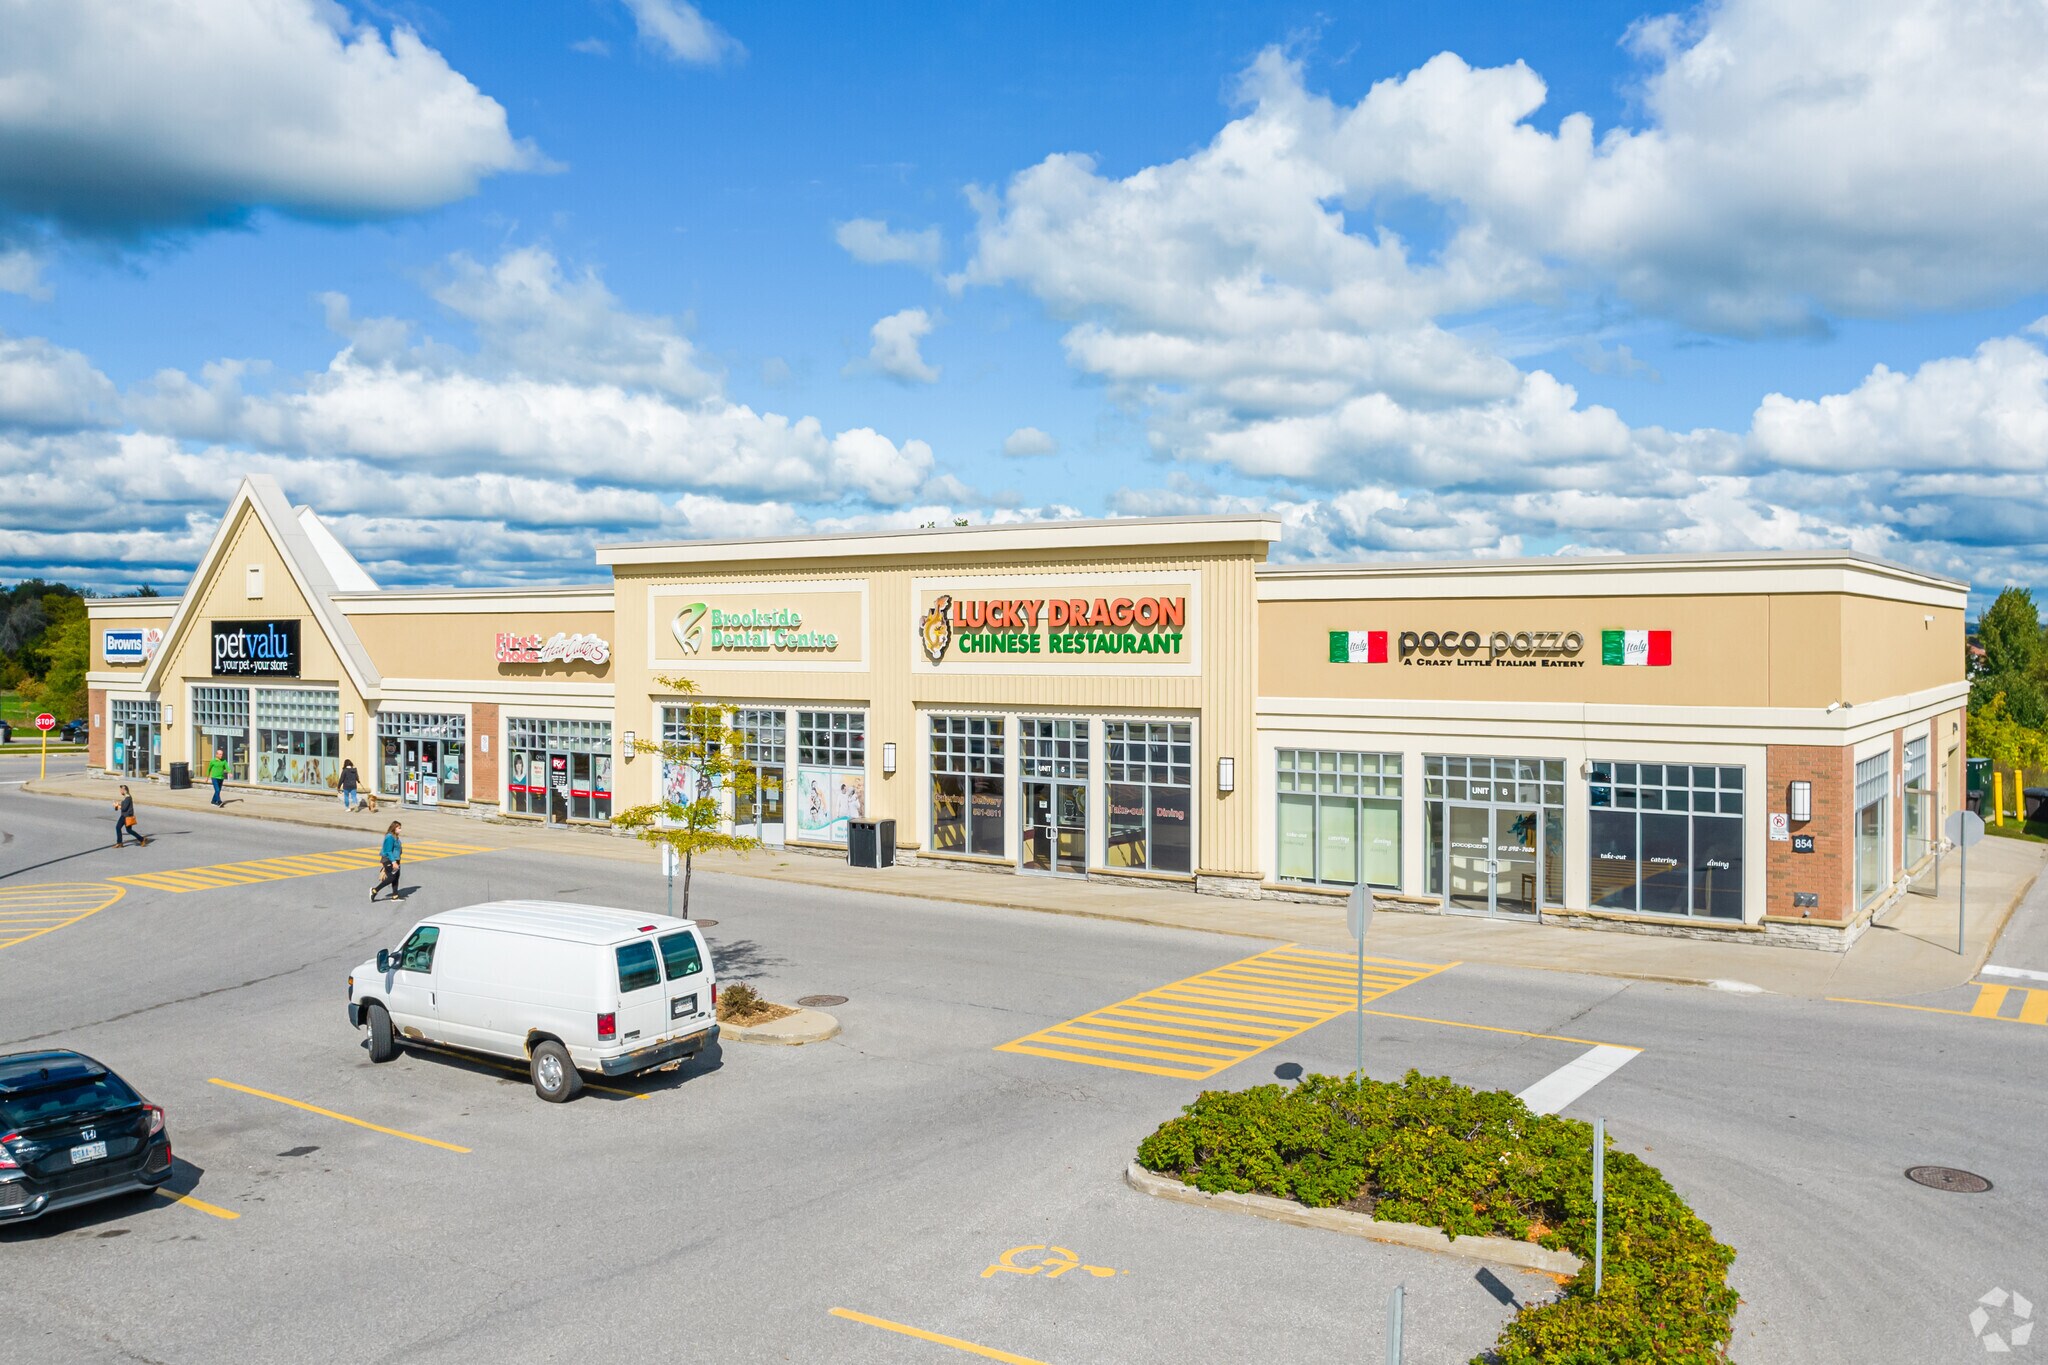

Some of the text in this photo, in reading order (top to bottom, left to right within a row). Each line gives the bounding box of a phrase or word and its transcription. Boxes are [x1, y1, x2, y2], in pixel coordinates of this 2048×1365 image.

[711, 608, 801, 626] Brookside
[953, 597, 1186, 628] LUCKY DRAGON
[107, 635, 142, 650] Browns
[496, 633, 539, 648] First
[711, 628, 838, 647] Dental Centre
[959, 632, 1183, 654] CHINESE RESTAURANT
[1400, 631, 1584, 657] poco pazzo
[1350, 639, 1367, 652] Italy
[1626, 639, 1647, 654] Italy
[495, 647, 539, 663] Choice
[1404, 658, 1412, 666] A
[223, 659, 288, 673] your pet your store
[36, 718, 55, 726] STOP
[1472, 787, 1508, 796] UNIT 6
[1156, 807, 1184, 820] Dining
[1795, 839, 1812, 848] 854
[1600, 852, 1730, 869] take-out catering dining
